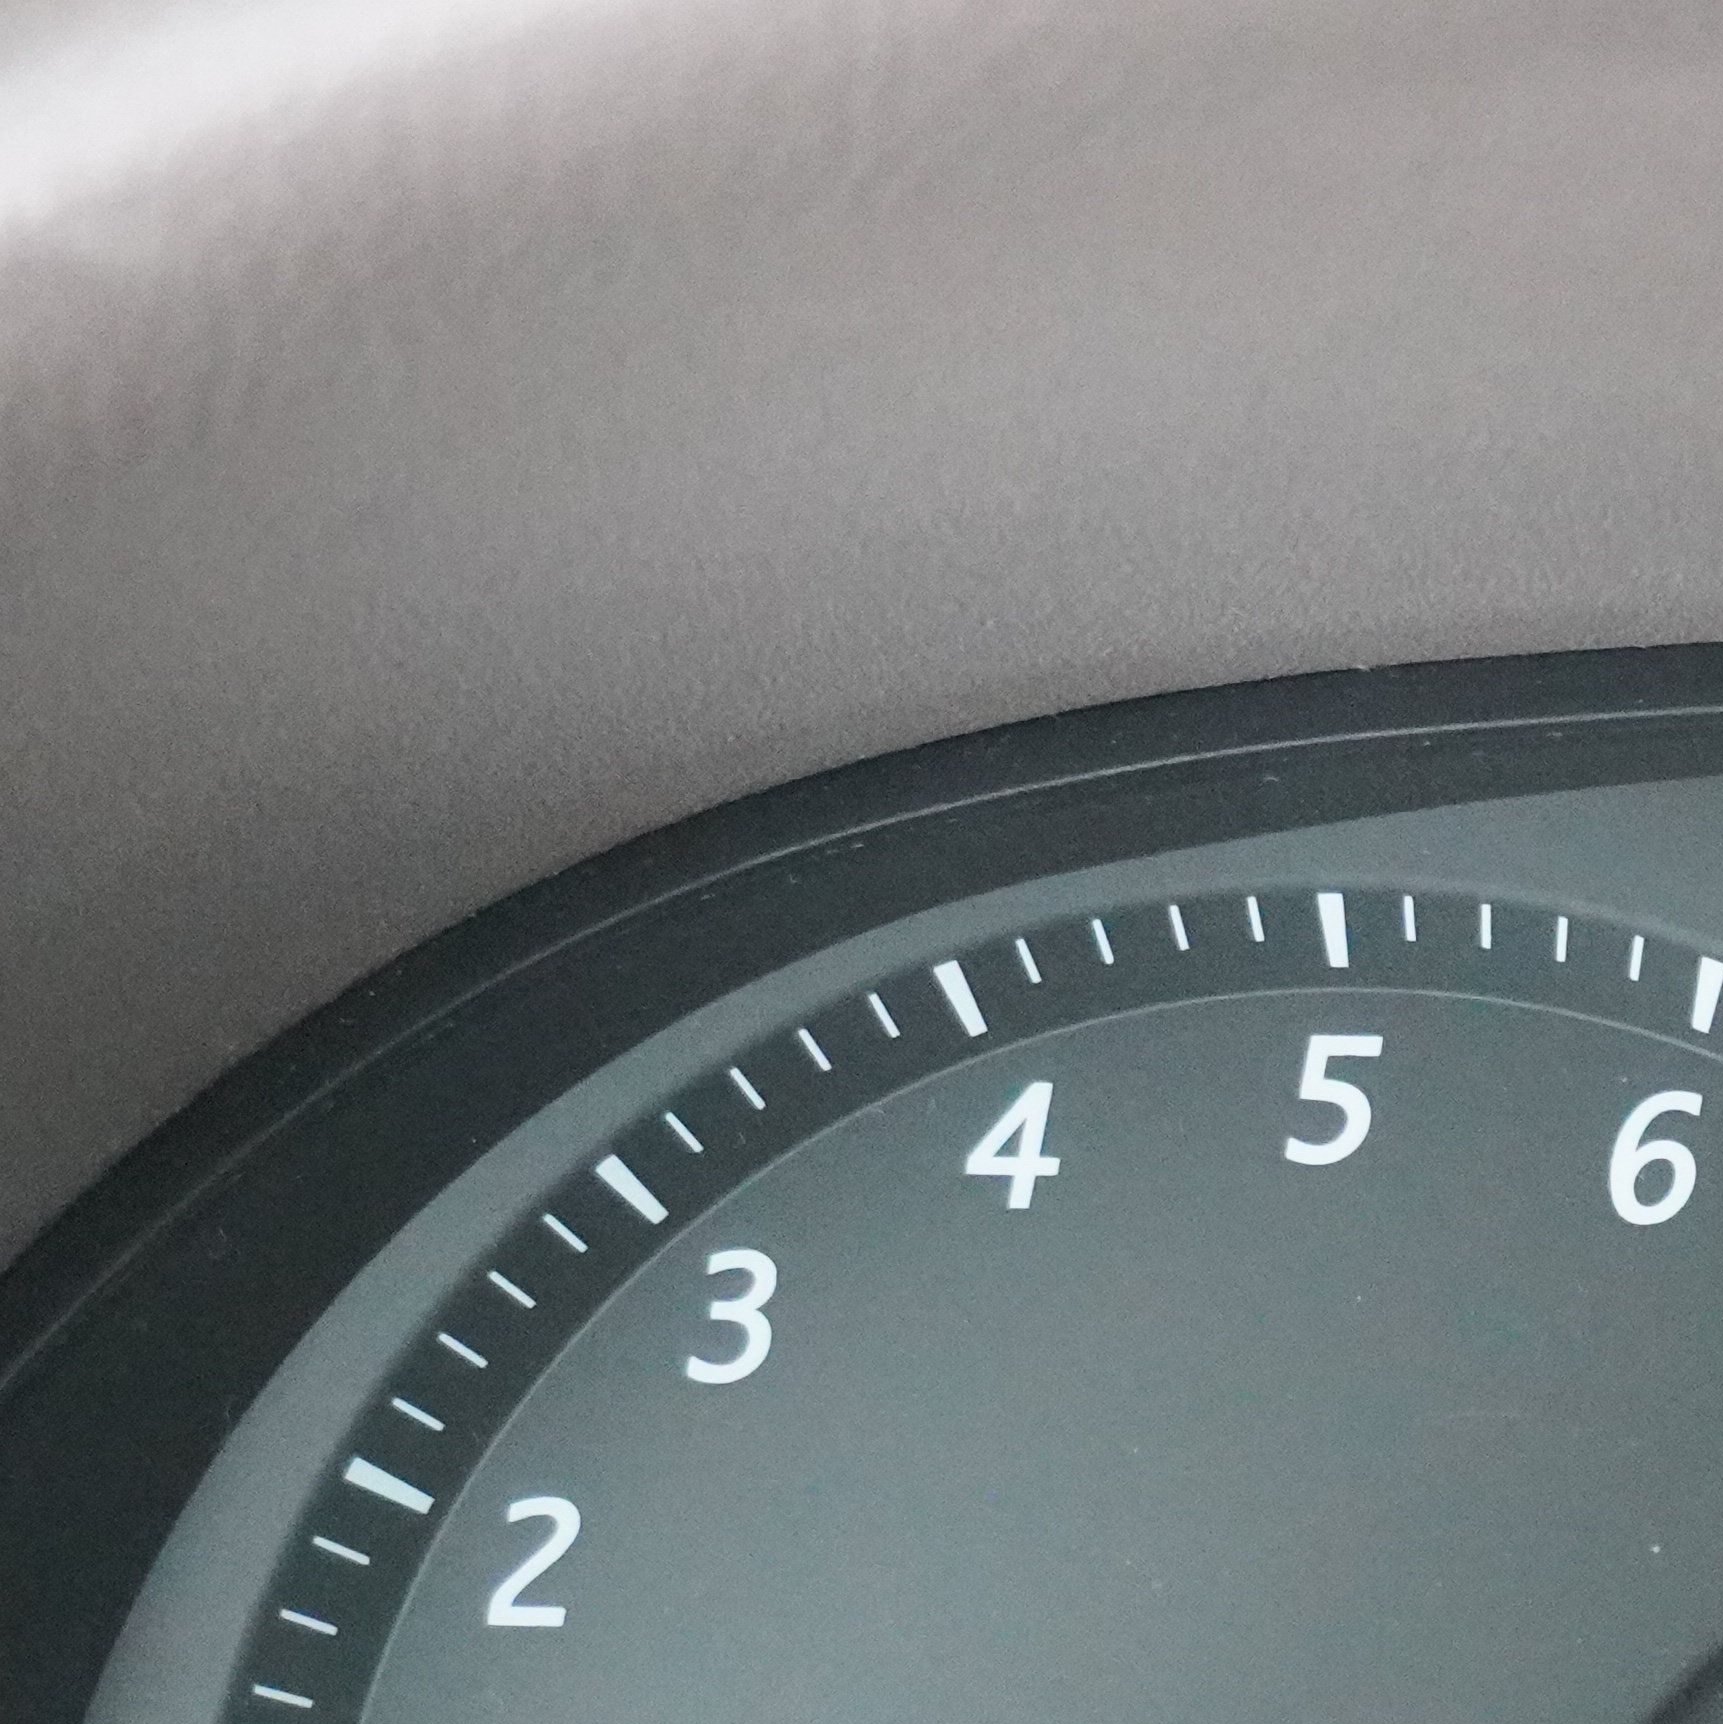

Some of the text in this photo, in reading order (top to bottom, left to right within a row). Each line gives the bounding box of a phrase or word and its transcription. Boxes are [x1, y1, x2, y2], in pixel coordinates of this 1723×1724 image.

[965, 1082, 1060, 1209] 4
[1285, 1035, 1383, 1165] 5
[1610, 1091, 1702, 1225] 6
[686, 1249, 777, 1383] 3
[487, 1497, 580, 1627] 2
